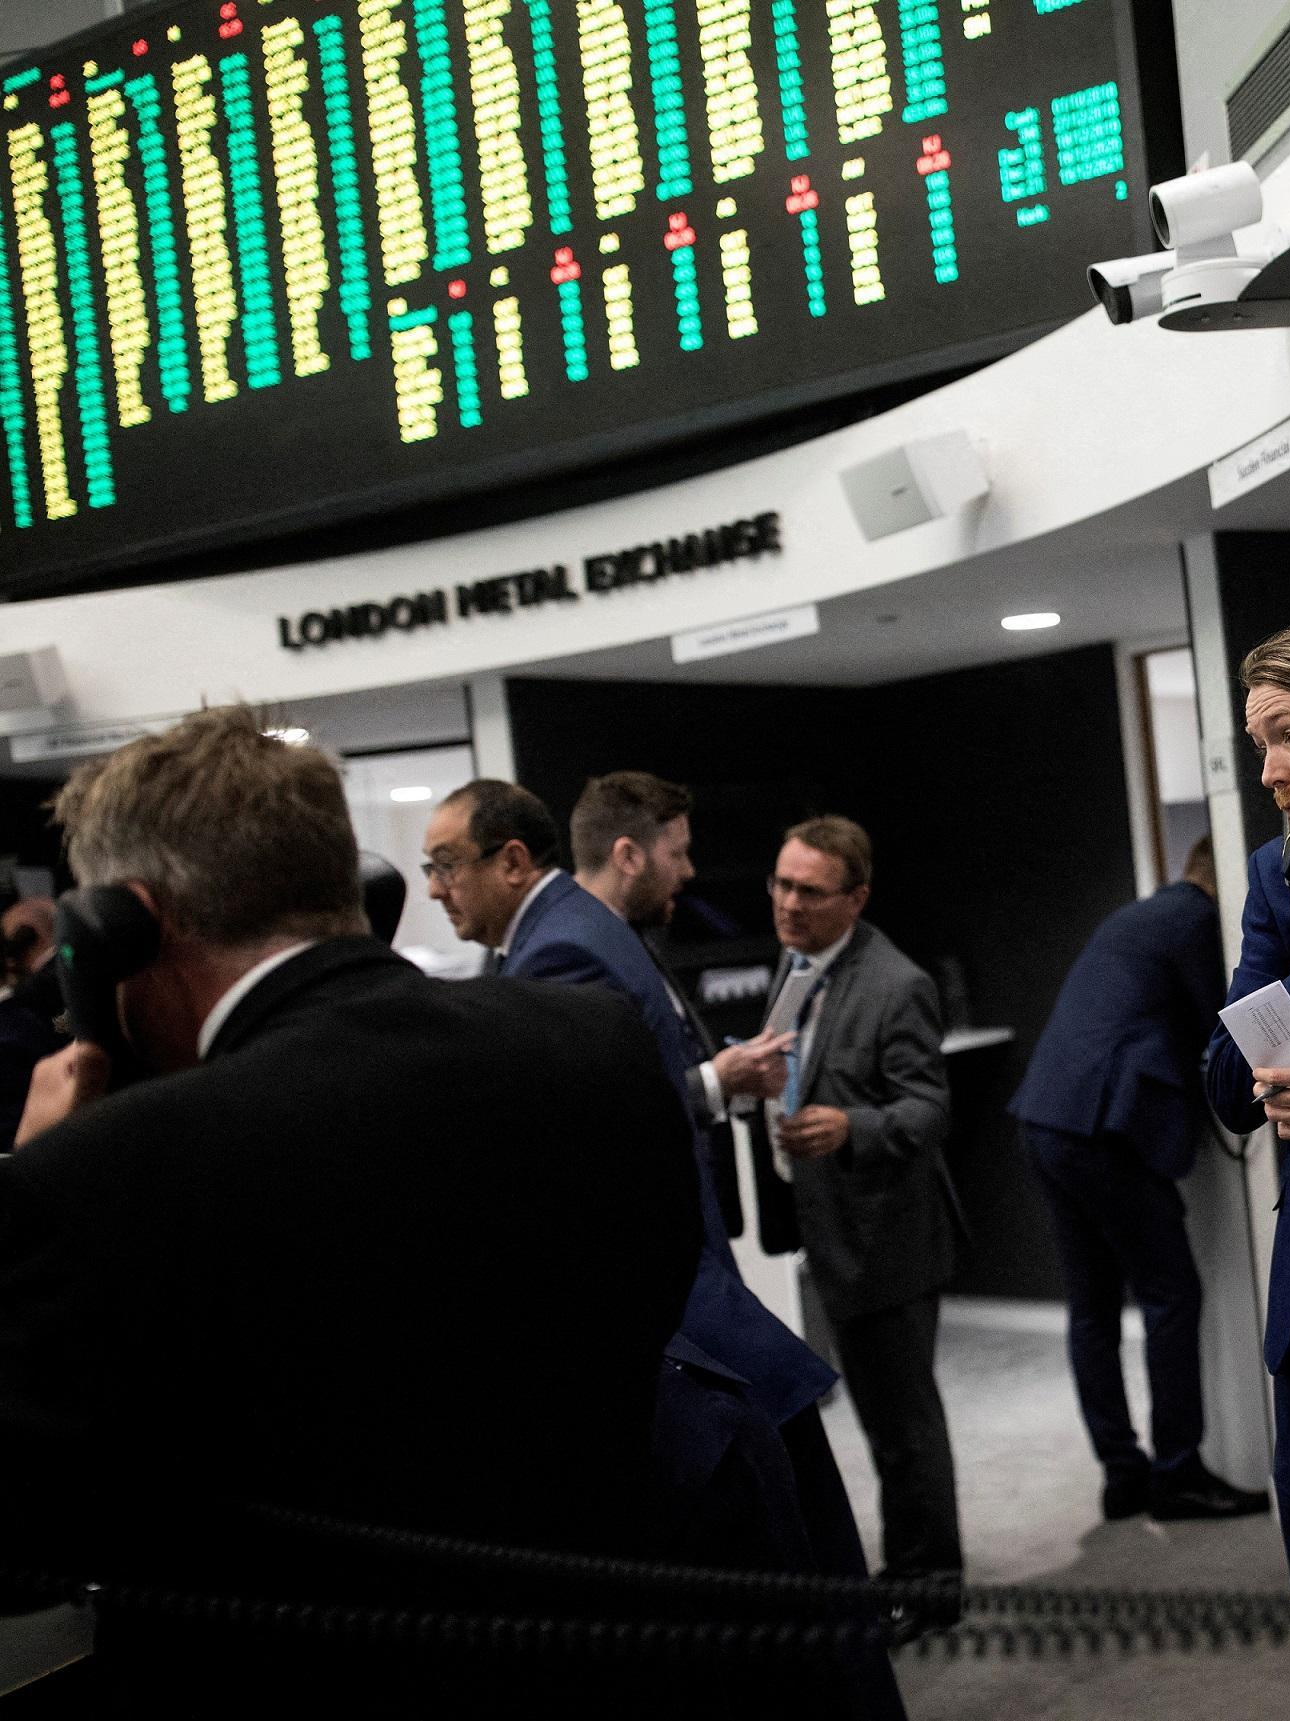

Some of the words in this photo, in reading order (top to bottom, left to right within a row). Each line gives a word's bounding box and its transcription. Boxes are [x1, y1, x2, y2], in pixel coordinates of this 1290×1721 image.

[278, 587, 448, 652] LONDON
[454, 564, 579, 618] METAL
[583, 511, 783, 594] EXCHANGE
